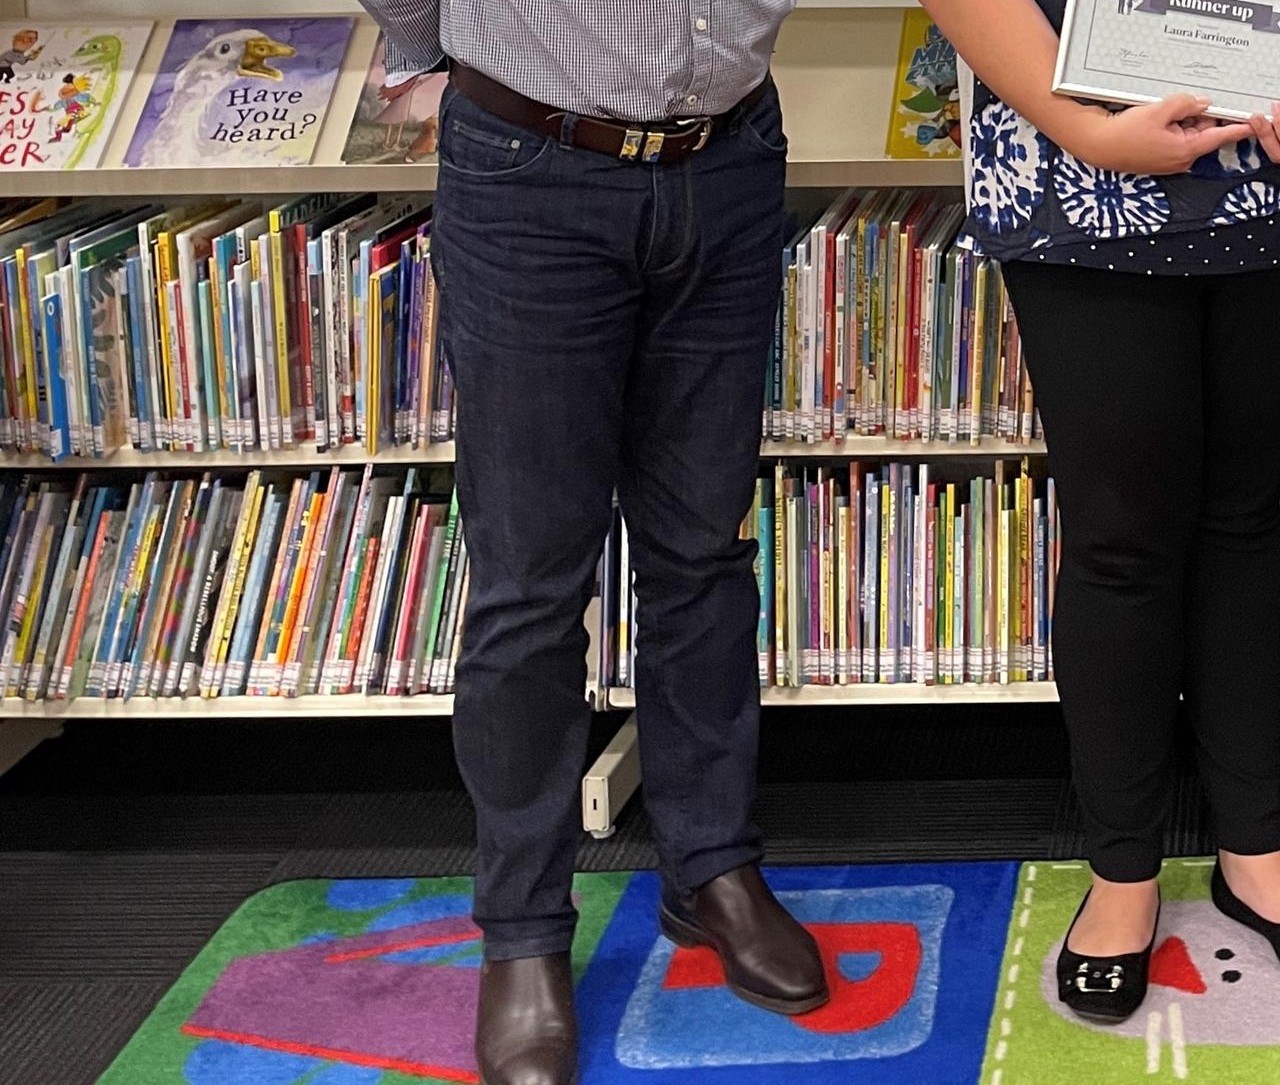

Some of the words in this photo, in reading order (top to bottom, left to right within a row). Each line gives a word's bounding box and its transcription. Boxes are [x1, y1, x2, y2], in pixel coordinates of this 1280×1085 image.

[1232, 5, 1254, 22] up
[1164, 24, 1193, 38] Laura
[1195, 29, 1250, 47] Farrington
[226, 86, 303, 107] Have
[209, 113, 317, 143] heard?
[233, 107, 289, 129] you
